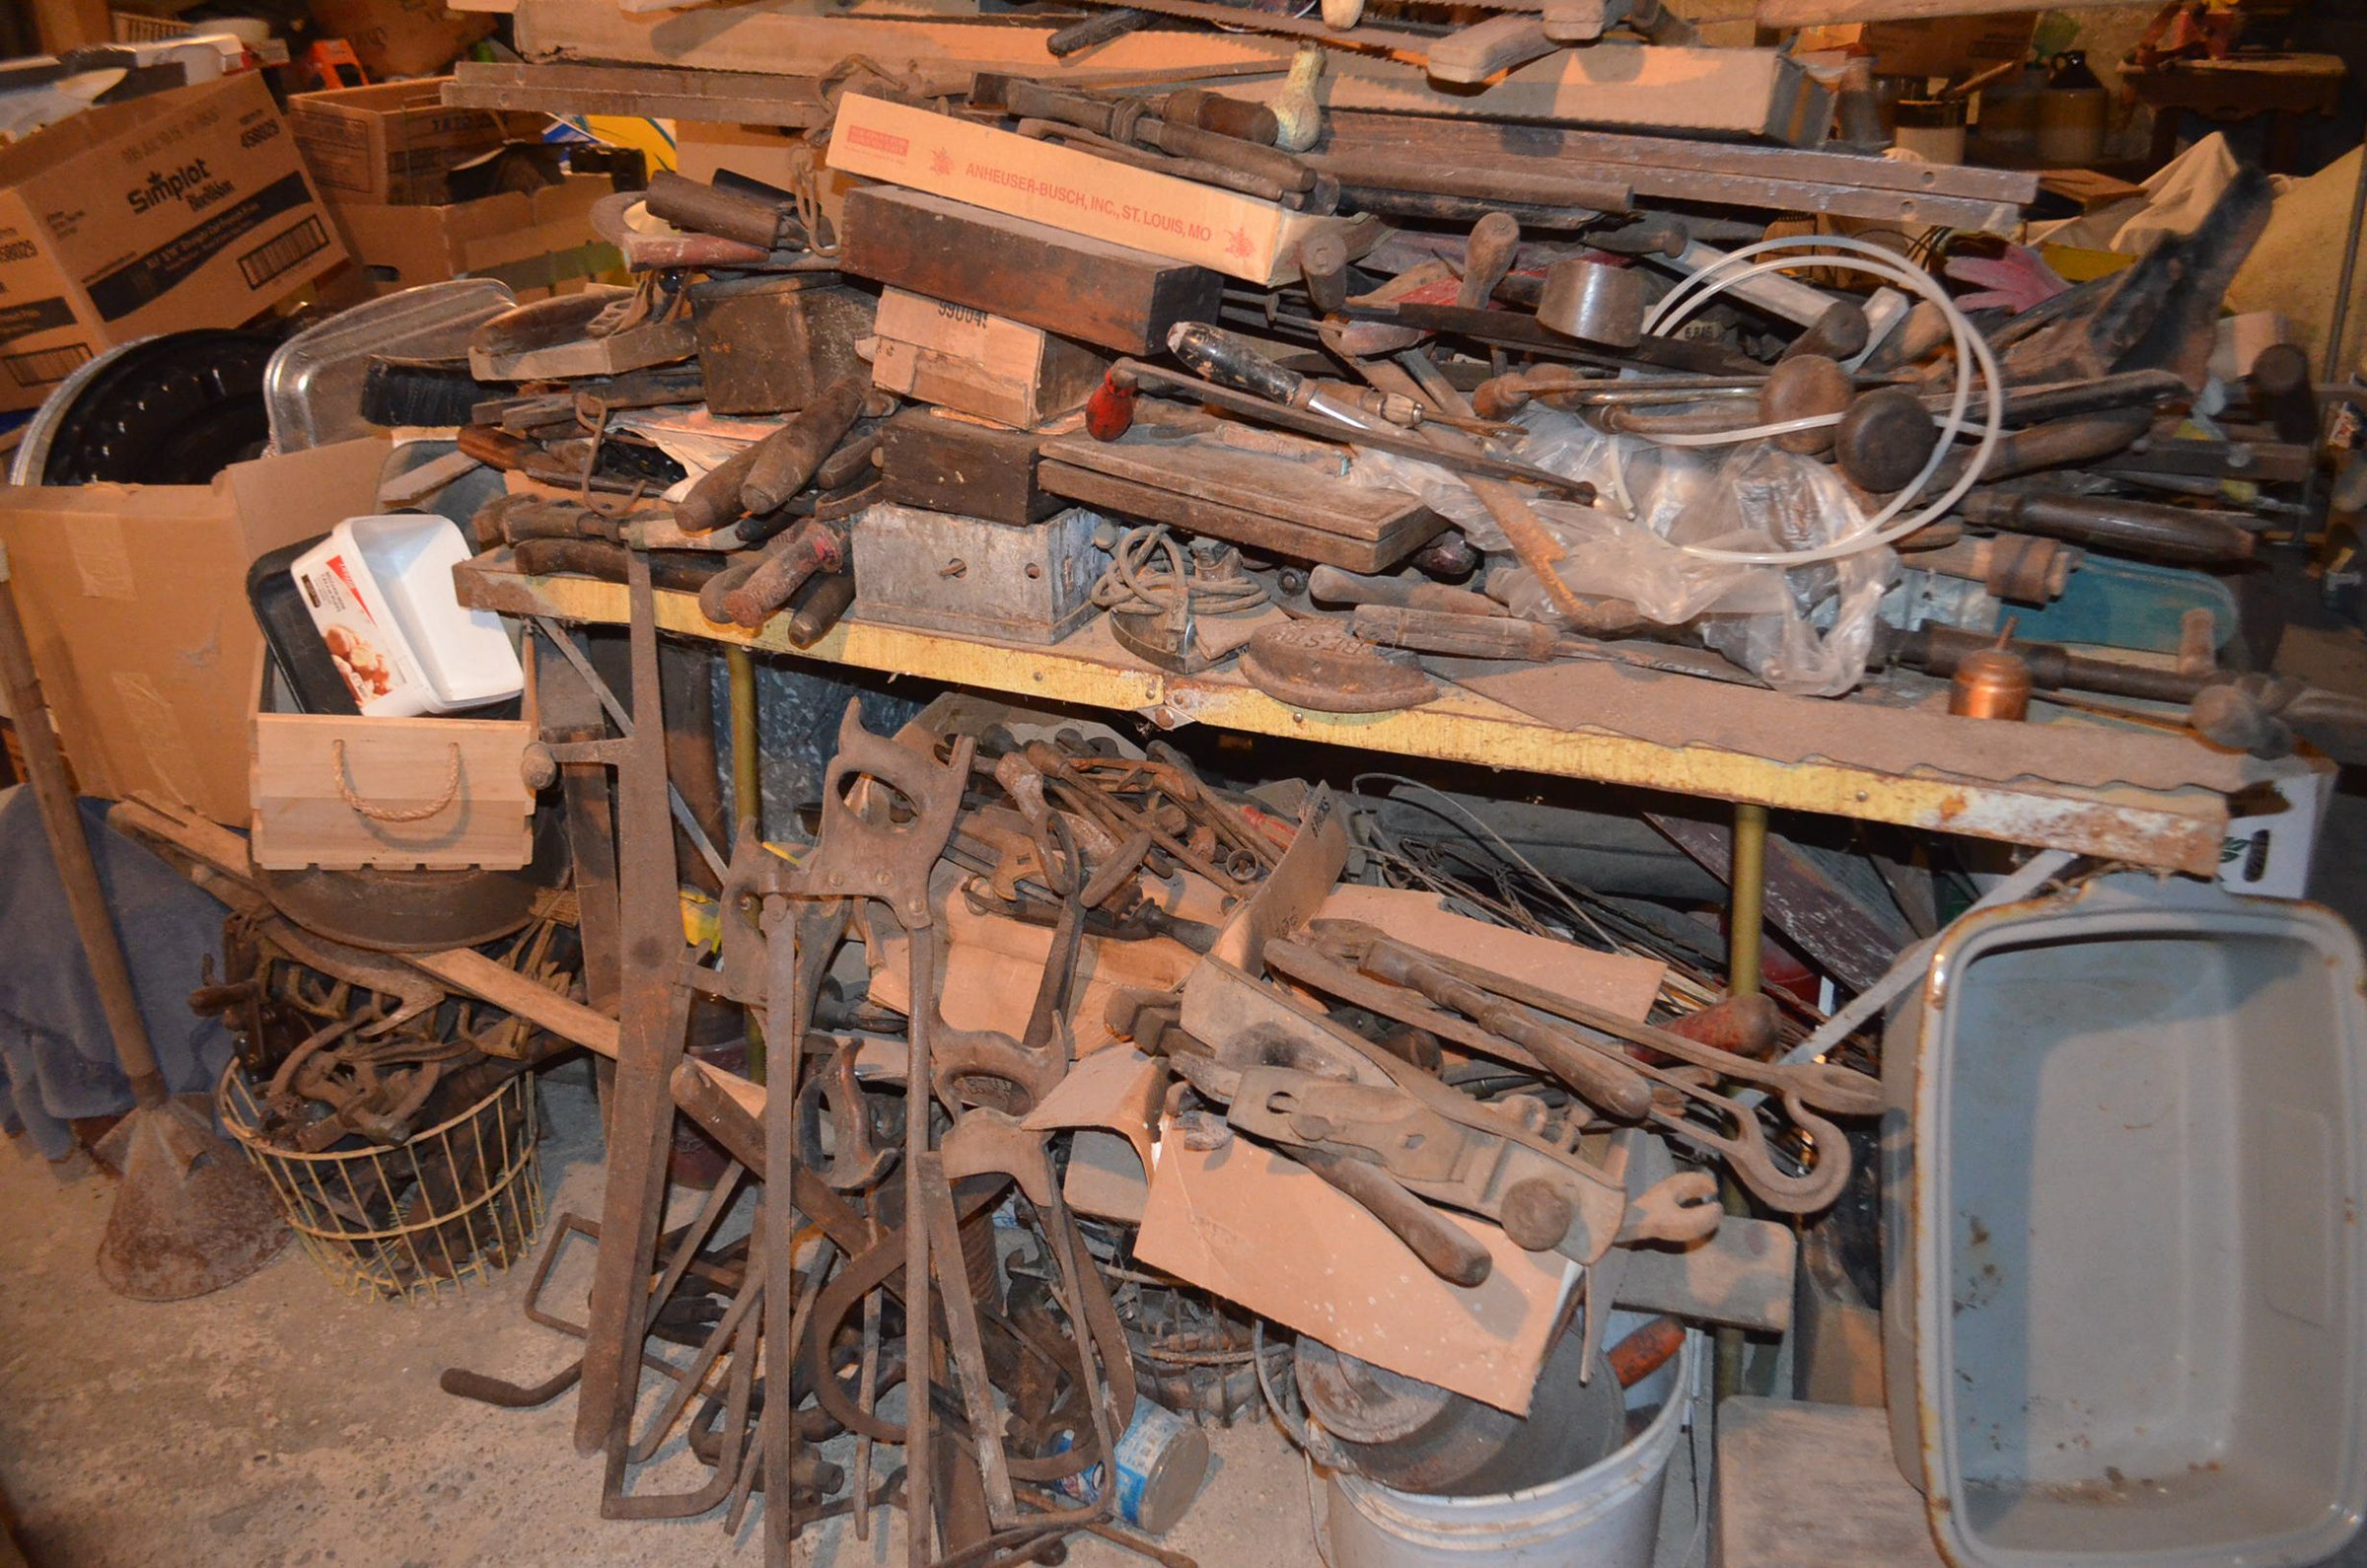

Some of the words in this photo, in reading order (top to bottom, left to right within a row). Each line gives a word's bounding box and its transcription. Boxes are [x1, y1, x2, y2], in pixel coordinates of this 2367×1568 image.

[126, 158, 211, 214] Simplot
[966, 163, 1088, 211] ANHEUSER-BUSCH,
[1121, 204, 1141, 223] ST.
[1143, 207, 1186, 238] LOUIS,
[1187, 223, 1212, 243] MO
